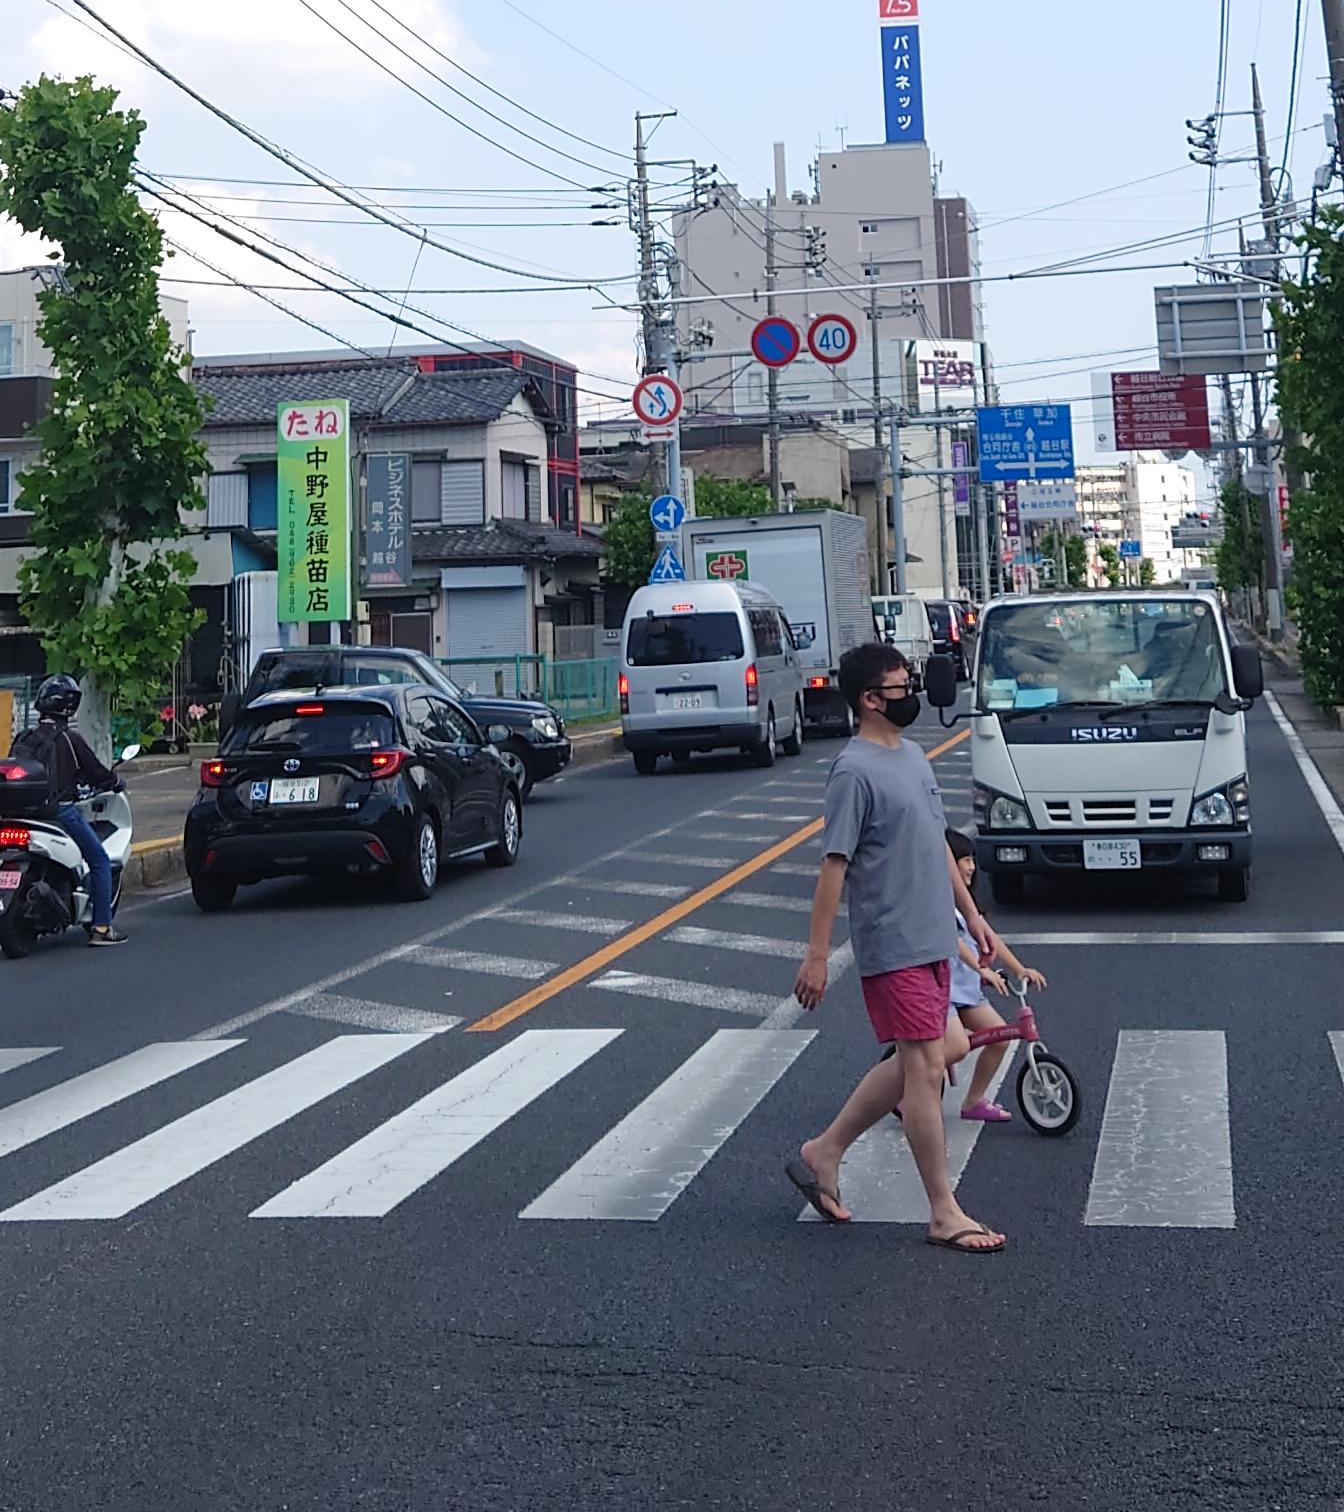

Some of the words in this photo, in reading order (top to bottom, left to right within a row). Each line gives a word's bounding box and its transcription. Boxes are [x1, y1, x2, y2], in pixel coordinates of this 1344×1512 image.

[819, 327, 846, 350] 40
[287, 410, 338, 436] たね
[388, 459, 403, 550] ビジネスホテル
[306, 446, 329, 613] 中野屋種苗店
[1071, 727, 1137, 740] ISUZU
